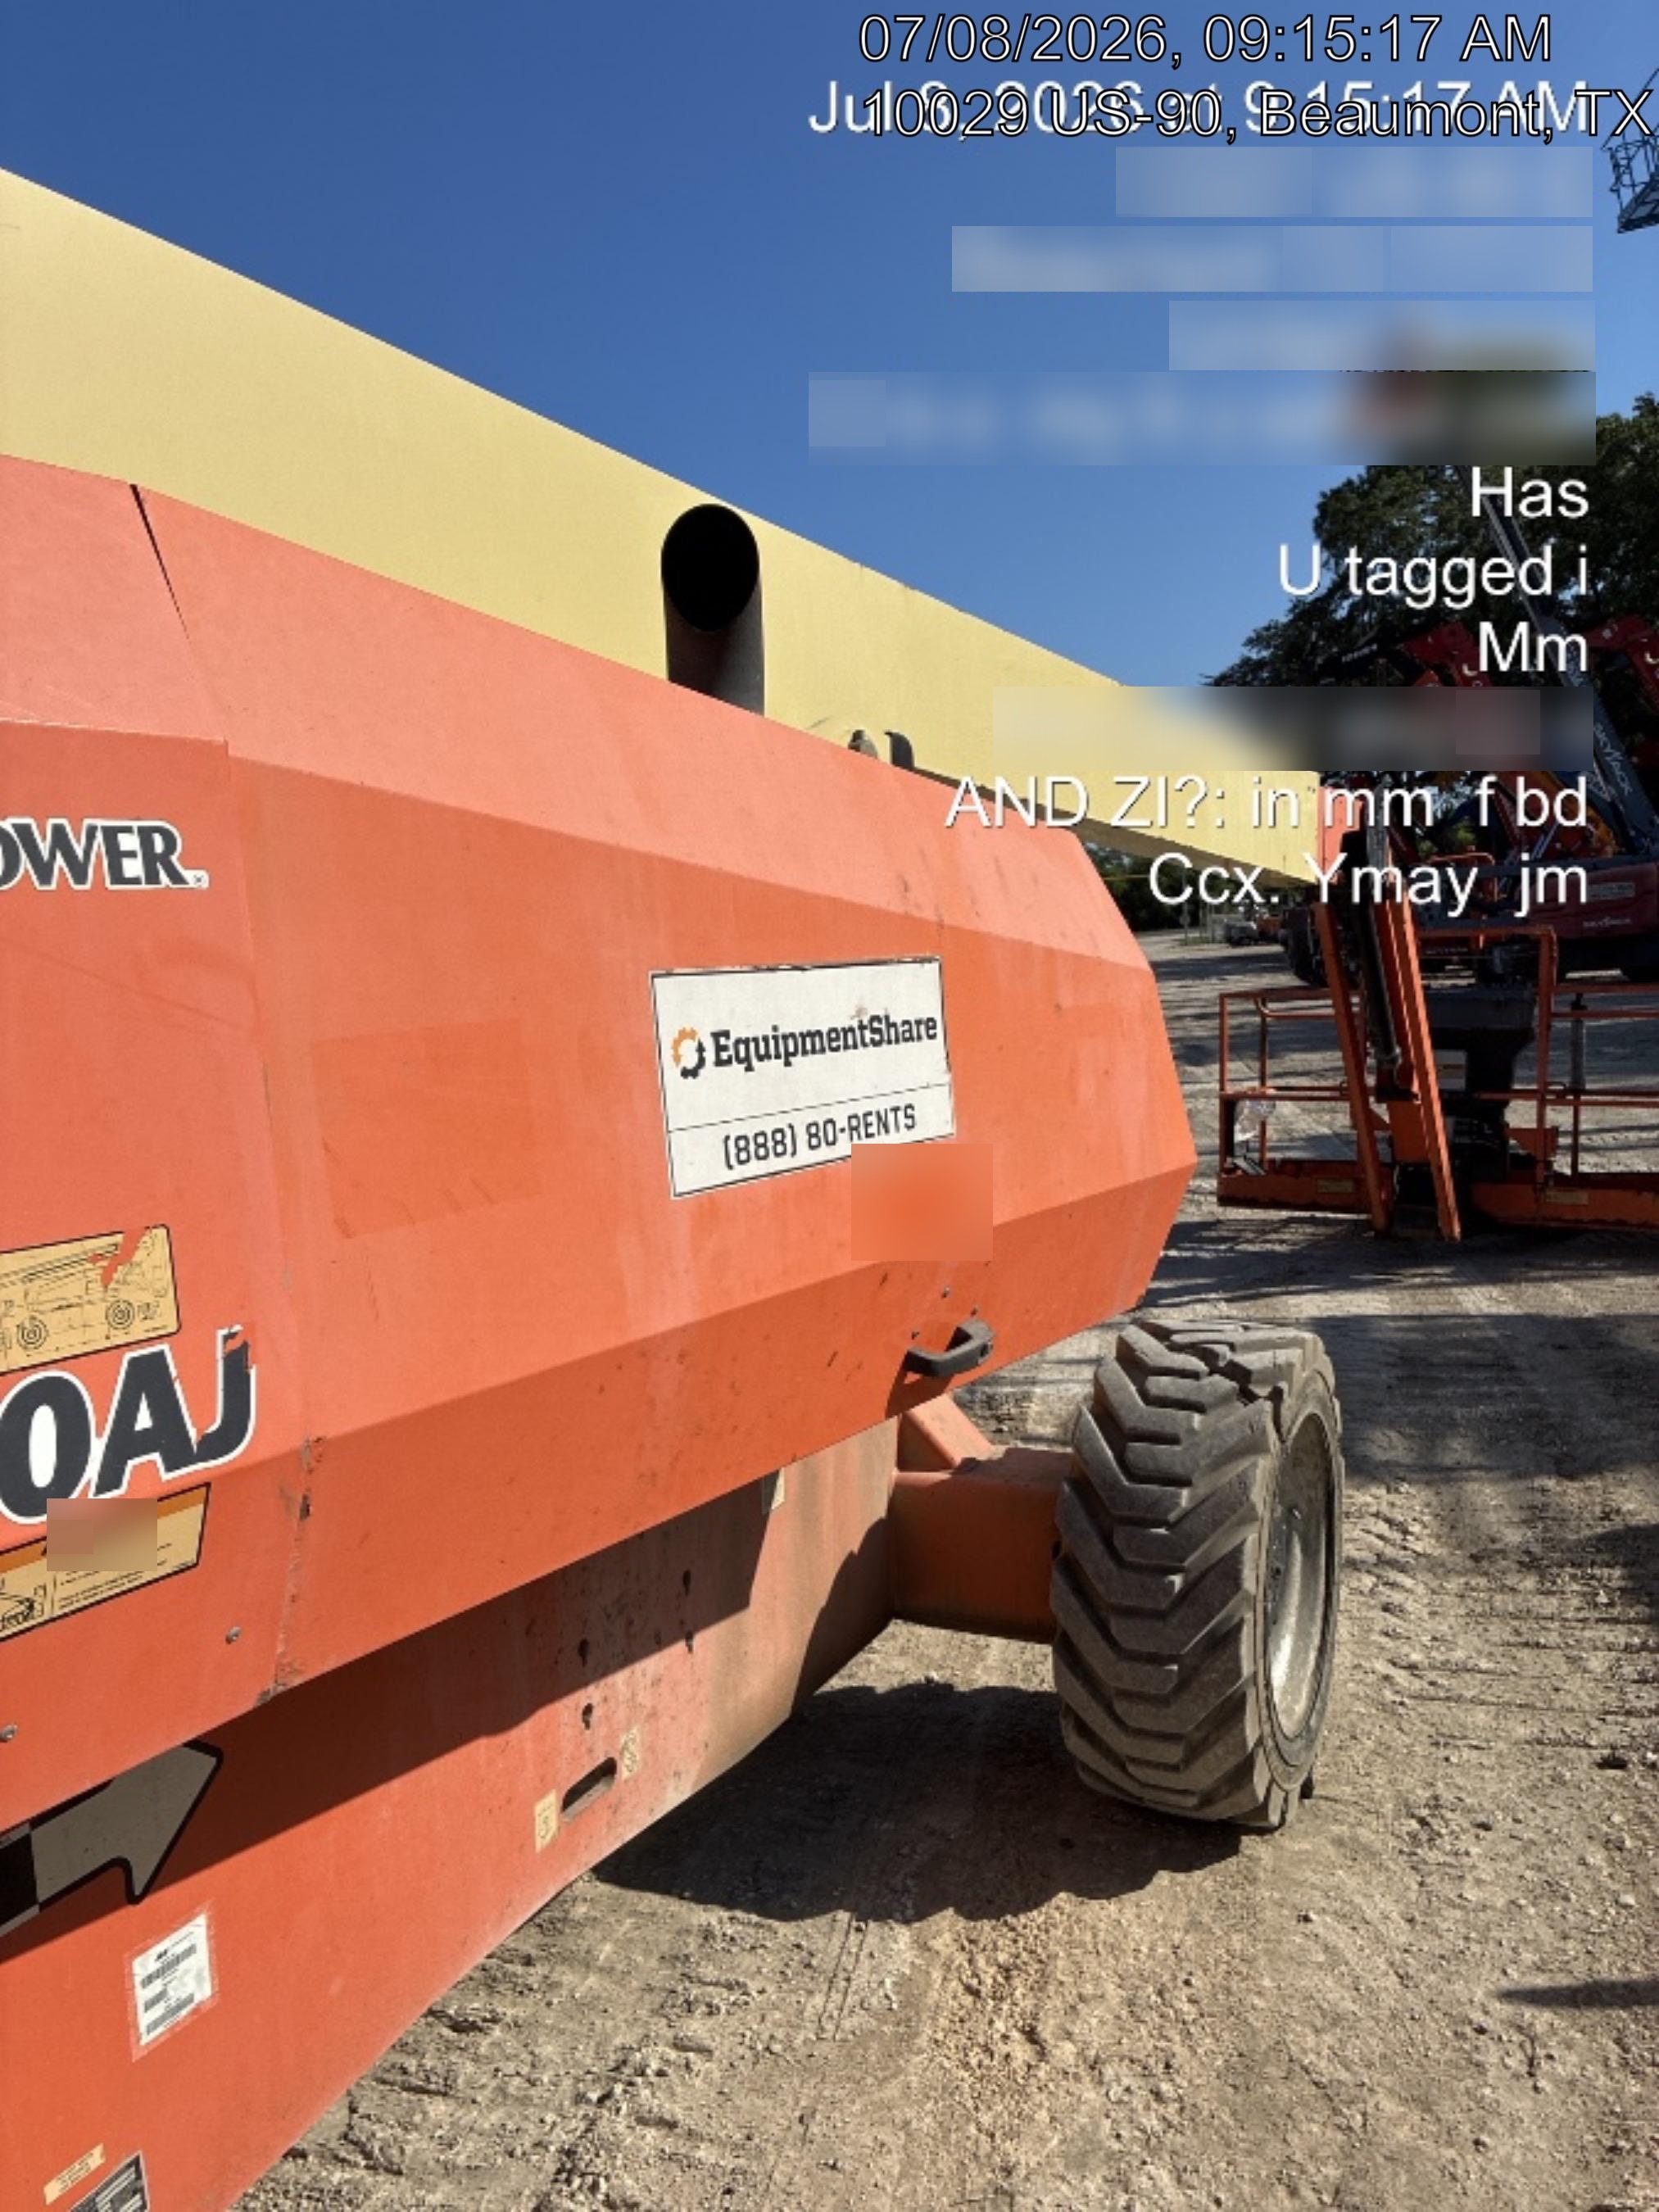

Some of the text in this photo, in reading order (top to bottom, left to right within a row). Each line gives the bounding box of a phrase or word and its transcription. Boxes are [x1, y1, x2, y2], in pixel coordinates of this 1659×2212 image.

[710, 1014, 937, 1072] EquipmentShare
[723, 1104, 917, 1170] (888) 80-RENTS
